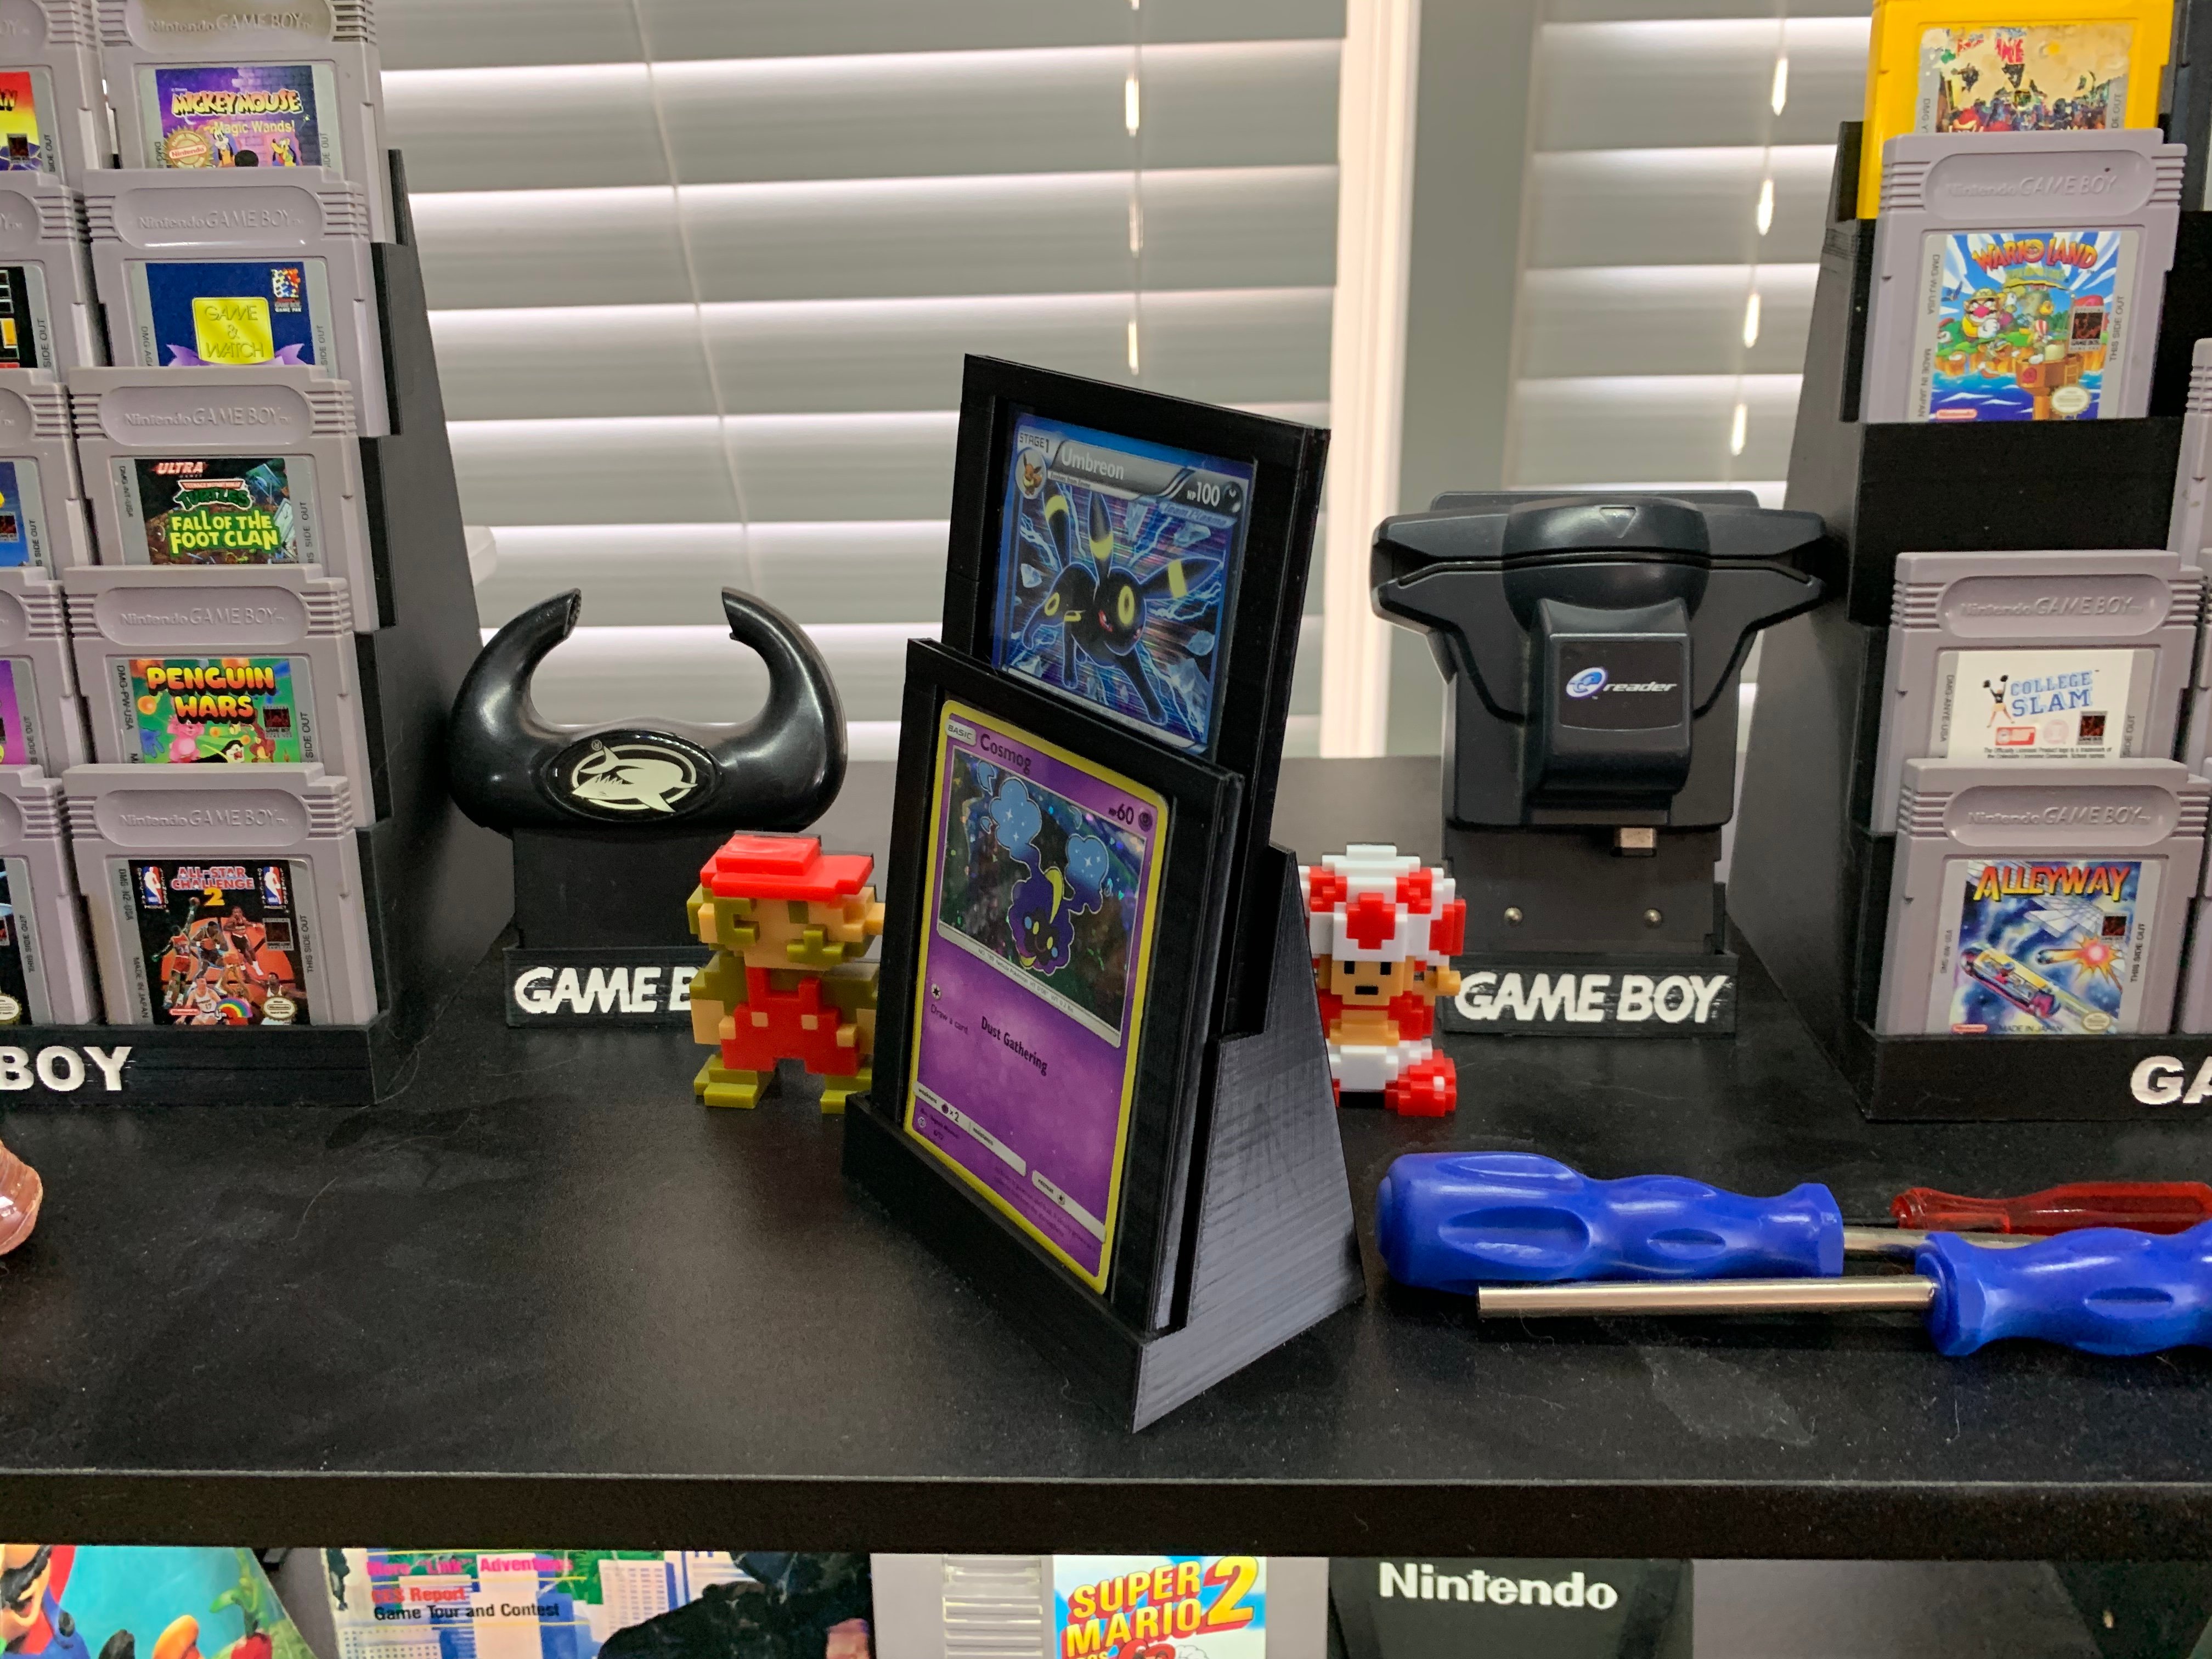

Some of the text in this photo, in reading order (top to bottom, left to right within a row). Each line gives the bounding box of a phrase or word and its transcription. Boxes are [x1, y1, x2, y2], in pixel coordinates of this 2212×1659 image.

[150, 12, 302, 33] Nintendo GAME BOY
[172, 88, 303, 117] MICKEY MOUSE
[214, 120, 295, 137] Magic Wands!
[43, 134, 53, 151] OUT
[320, 132, 329, 149] OUT
[172, 147, 205, 157] Nintendo
[2019, 177, 2079, 196] GAME
[2080, 174, 2118, 195] BOY
[139, 209, 291, 229] Nintendo GAME BOY
[1971, 236, 2098, 273] WARIO LAND
[204, 304, 258, 321] GAME
[226, 324, 240, 340] &
[2108, 295, 2125, 363] THIS SIDE OUT
[37, 318, 52, 369] SIDE OUT
[206, 342, 265, 358] WATCH
[316, 325, 329, 366] SIDE OUT
[1923, 348, 1932, 374] MADE
[1917, 388, 1928, 419] JAPAN
[124, 407, 278, 427] Nintendo GAME BOY
[157, 461, 204, 475] ULTRA
[1060, 445, 1125, 481] Umbreon
[174, 489, 251, 511] TURTLES
[1197, 481, 1221, 507] 100
[29, 519, 38, 538] OUT
[171, 510, 273, 531] FALL OF THE
[300, 501, 313, 548] SIDE OUT
[32, 539, 42, 558] SIDE
[170, 529, 280, 555] FOOT CLAN
[120, 607, 277, 626] Nintendo GAME BOY
[1961, 596, 2133, 617] Nintendo GAME BOY
[146, 666, 276, 696] PENGUIN
[1602, 681, 1678, 692] reader
[2010, 670, 2094, 696] COLLEGE
[174, 695, 256, 724] WARS
[2011, 689, 2092, 717] SLAM
[947, 724, 974, 741] BASIC
[2126, 714, 2135, 734] OUT
[23, 715, 37, 756] SIDE OUT
[300, 712, 314, 759] SIDE OUT
[980, 732, 1032, 777] Cosmog
[120, 809, 277, 828] Nintendo GAME BOY
[1116, 803, 1135, 826] 60
[1967, 806, 2142, 825] Nintendo GAME BOY
[177, 866, 247, 879] ALL-STAR
[170, 877, 256, 890] CHALLENGE
[1973, 866, 2131, 902] ALLEYWAY
[203, 887, 225, 906] 2
[300, 914, 309, 933] OUT
[302, 934, 312, 953] SIDE
[514, 966, 662, 1014] GAME
[1454, 971, 1729, 1023] GAME BOY
[930, 1003, 948, 1022] Draw
[981, 1015, 1048, 1076] Dust Gathering
[366, 1561, 411, 1576] More
[409, 1586, 466, 1603] Report
[1069, 1556, 1259, 1632] SUPER 2
[1378, 1561, 1618, 1610] Nintendo
[374, 1602, 561, 1621] Game Tour and Contest
[1065, 1598, 1203, 1659] MARIO
